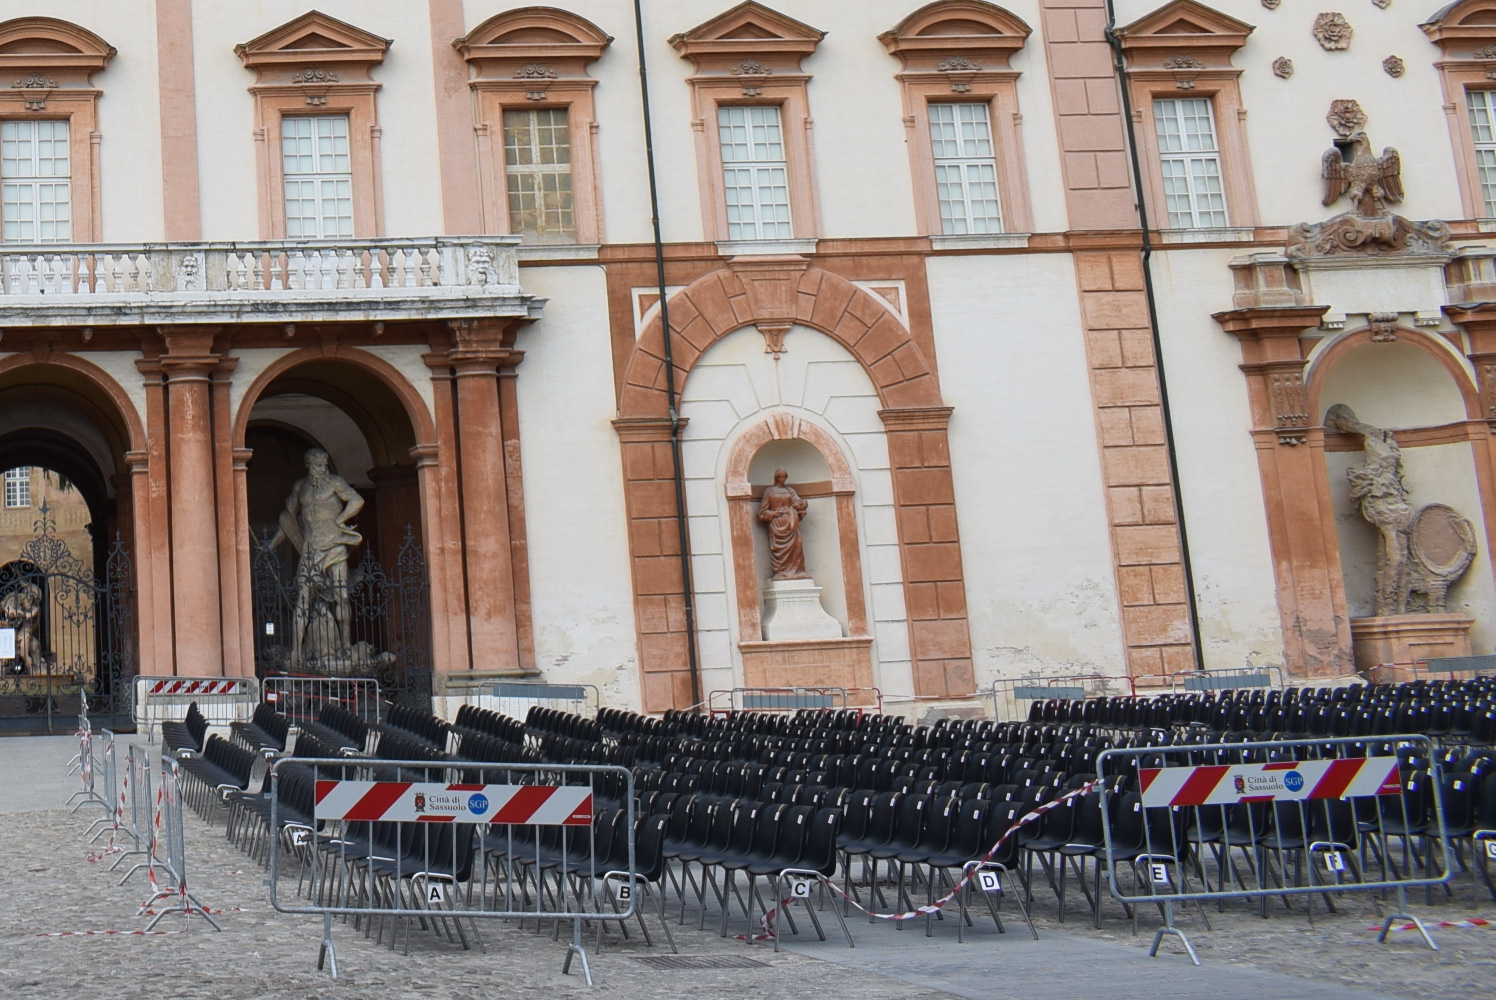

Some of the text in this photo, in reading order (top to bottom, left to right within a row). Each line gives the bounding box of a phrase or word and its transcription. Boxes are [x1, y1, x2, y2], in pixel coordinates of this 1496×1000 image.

[1247, 775, 1277, 784] Città di
[1285, 777, 1303, 786] SGP
[1248, 783, 1284, 791] Sassuolo
[429, 795, 460, 803] Città di
[429, 803, 467, 811] Sassuolo
[469, 800, 488, 809] SGP
[1152, 867, 1164, 880] E
[983, 875, 995, 888] D
[619, 885, 631, 899] B
[794, 882, 807, 895] C
[429, 886, 441, 901] A
